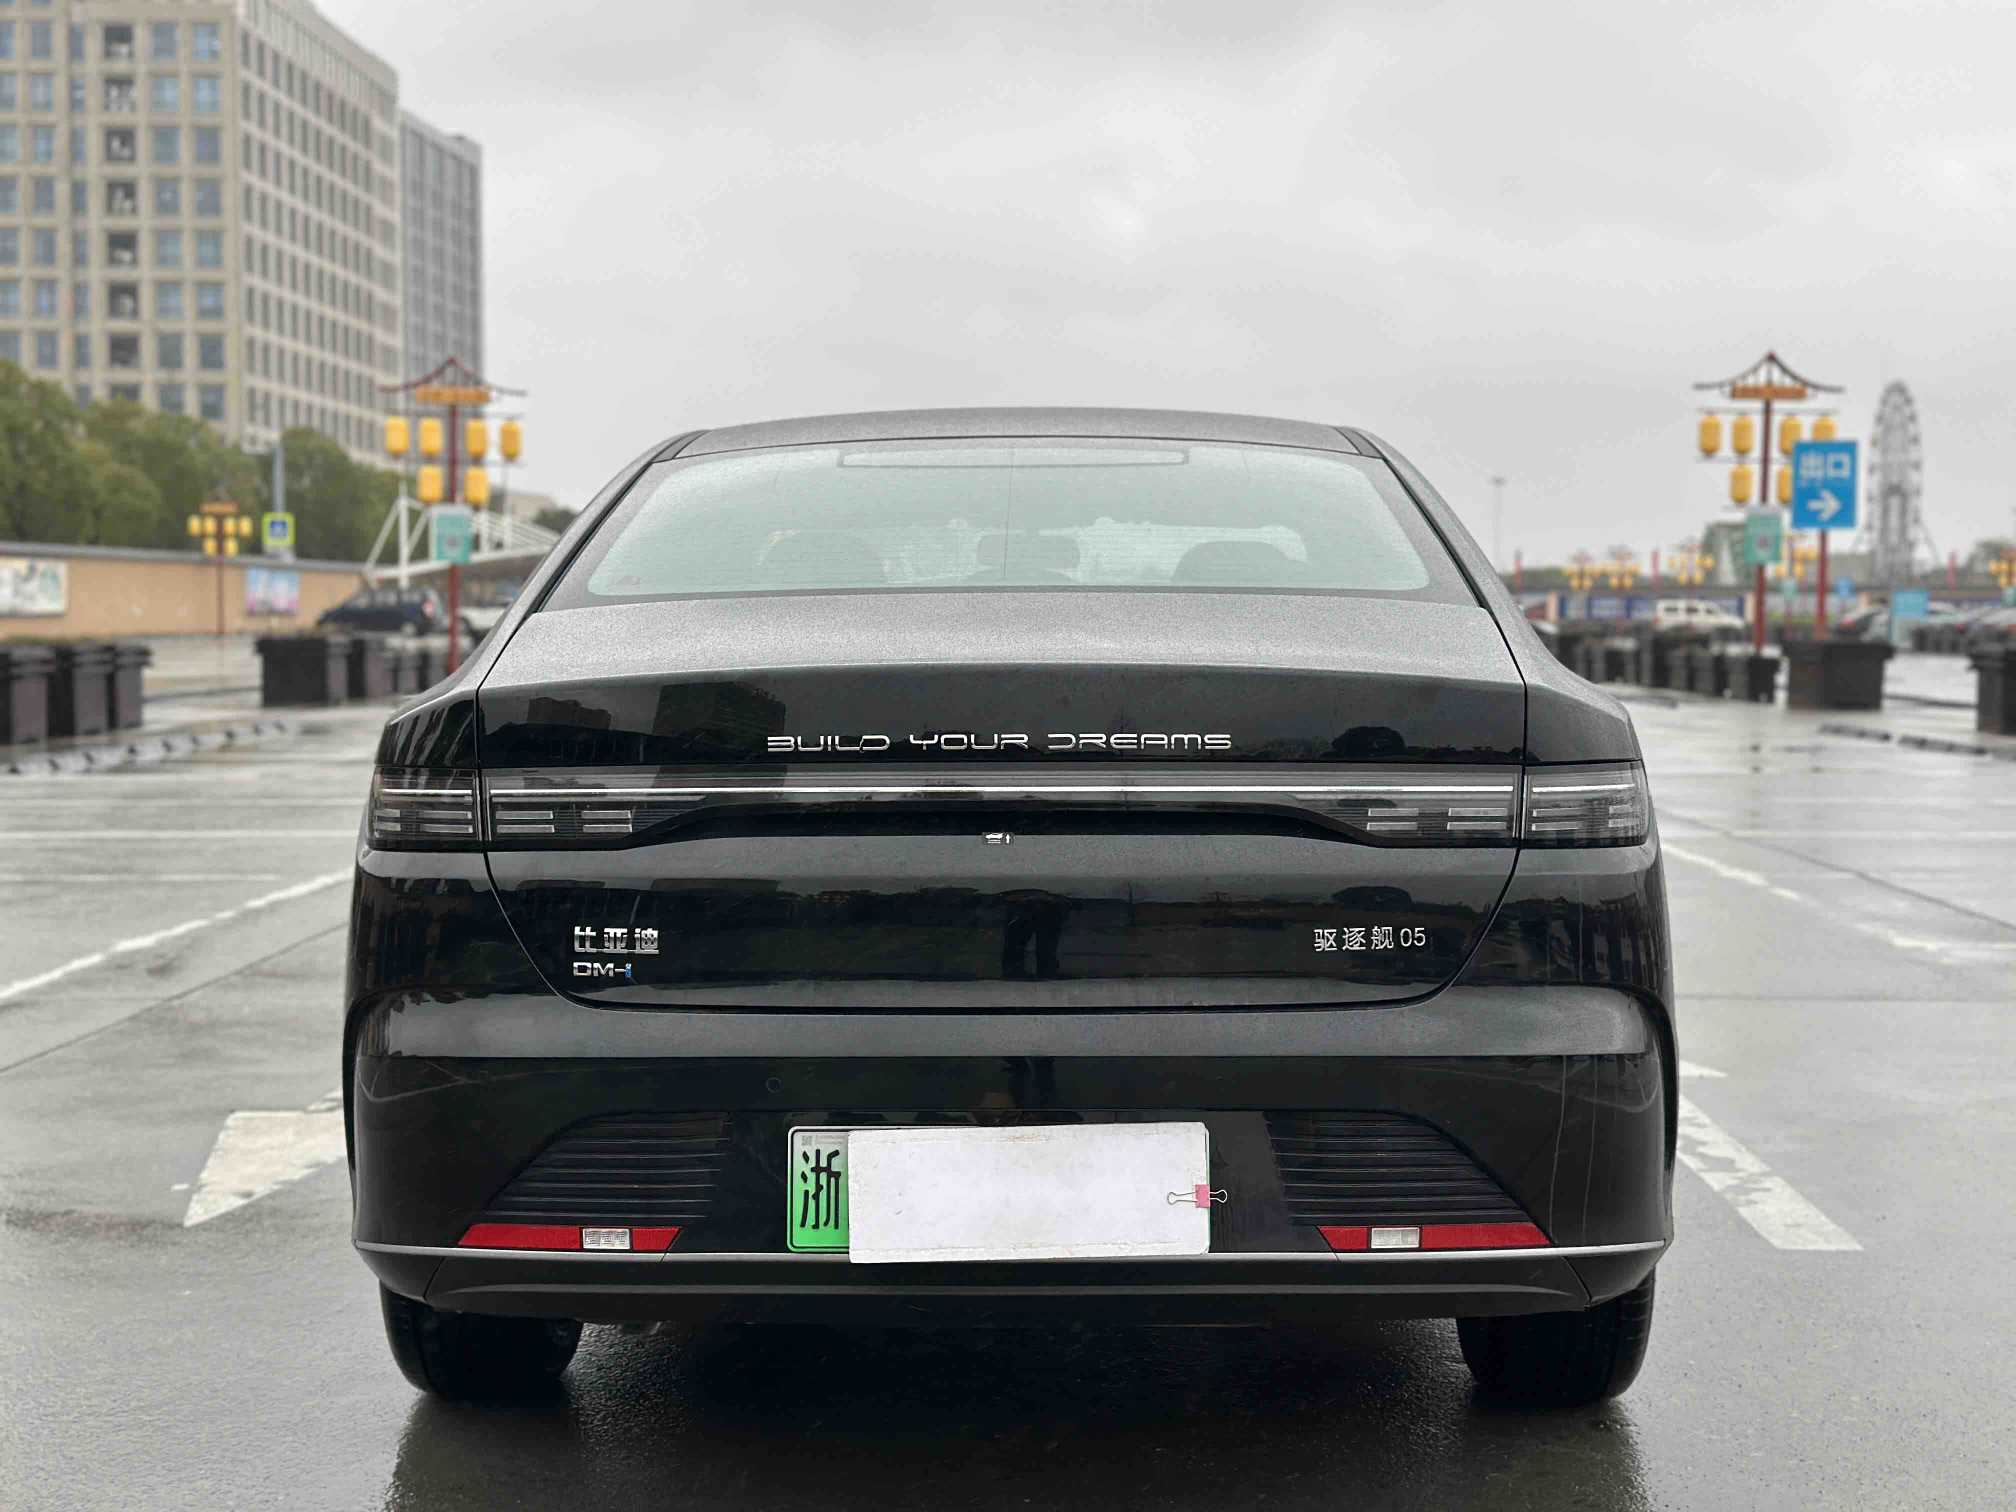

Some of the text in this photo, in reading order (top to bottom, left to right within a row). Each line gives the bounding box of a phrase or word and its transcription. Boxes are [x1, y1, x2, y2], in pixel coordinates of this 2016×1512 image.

[1799, 450, 1850, 480] 出口
[767, 733, 1232, 752] BUILD YOUR DREAMS
[573, 926, 660, 955] 比亚迪
[800, 1149, 842, 1230] 浙
